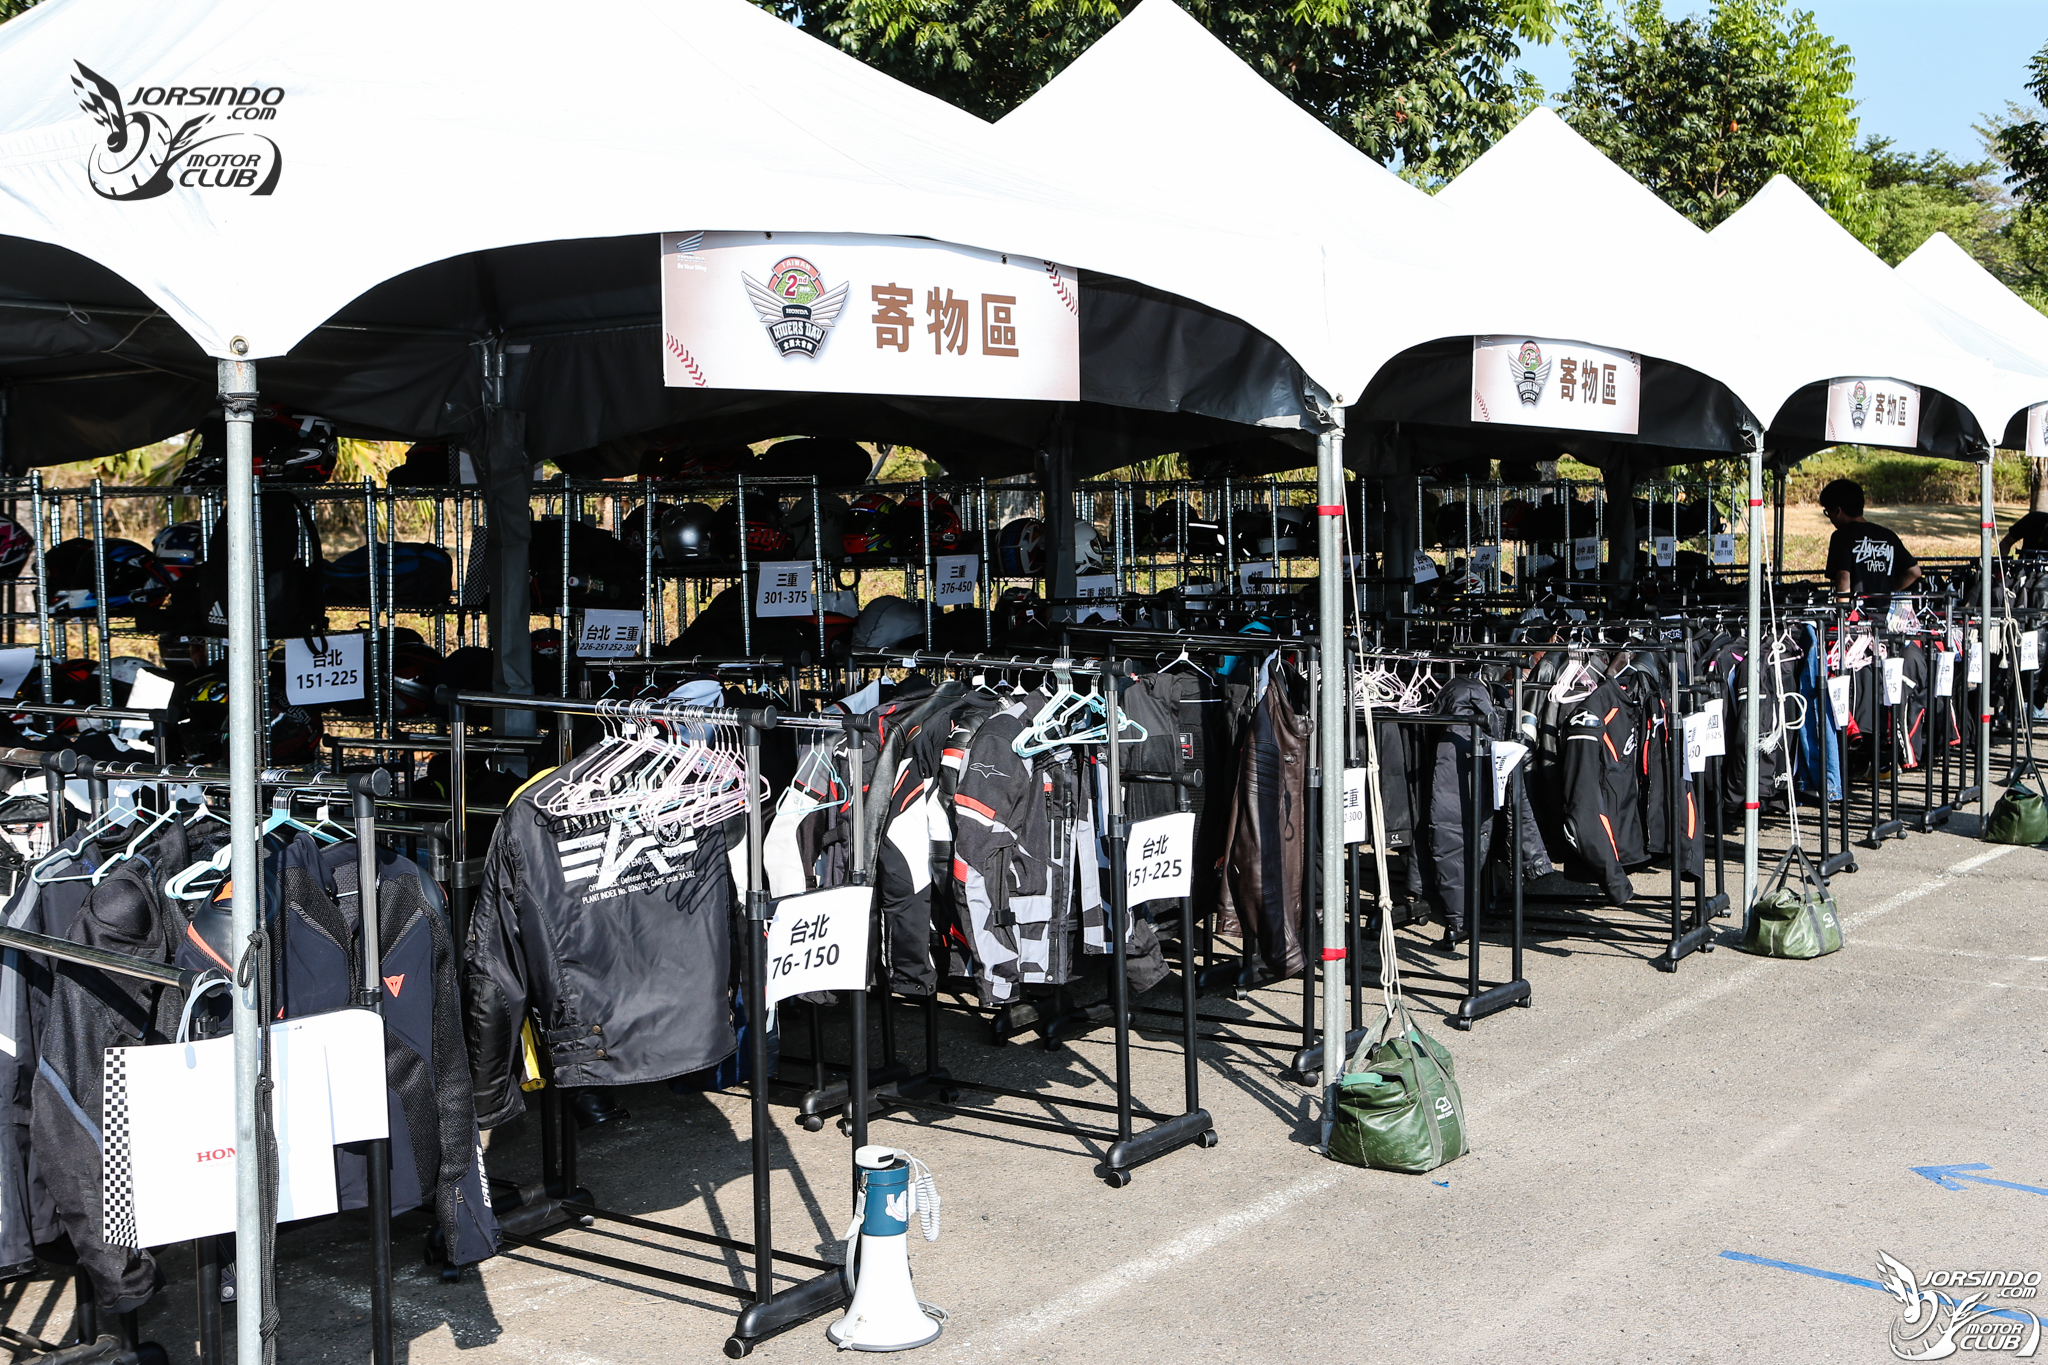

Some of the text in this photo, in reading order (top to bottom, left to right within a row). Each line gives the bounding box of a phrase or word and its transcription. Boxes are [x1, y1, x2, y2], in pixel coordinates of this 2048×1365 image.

[781, 259, 811, 271] TAIWAN
[870, 281, 1020, 358] 寄物區
[772, 320, 823, 341] RIDERS DAY
[1559, 356, 1617, 406] 寄物區
[1875, 392, 1907, 427] 寄物區
[776, 572, 799, 588] 三重
[949, 565, 966, 579] 三重
[763, 590, 808, 605] 301-375
[940, 580, 972, 595] 376-450
[586, 624, 640, 642] 台北 三重
[579, 642, 608, 651] 226-251
[312, 648, 343, 669] 台北
[296, 669, 358, 690] 151-225
[1142, 833, 1169, 861] 台北
[1127, 858, 1183, 889] 151-225
[582, 892, 600, 905] PLANT
[599, 888, 618, 901] INDEX
[650, 876, 666, 888] CAGE
[789, 913, 831, 946] 台北
[772, 943, 840, 980] 76-150
[196, 1147, 236, 1163] HON
